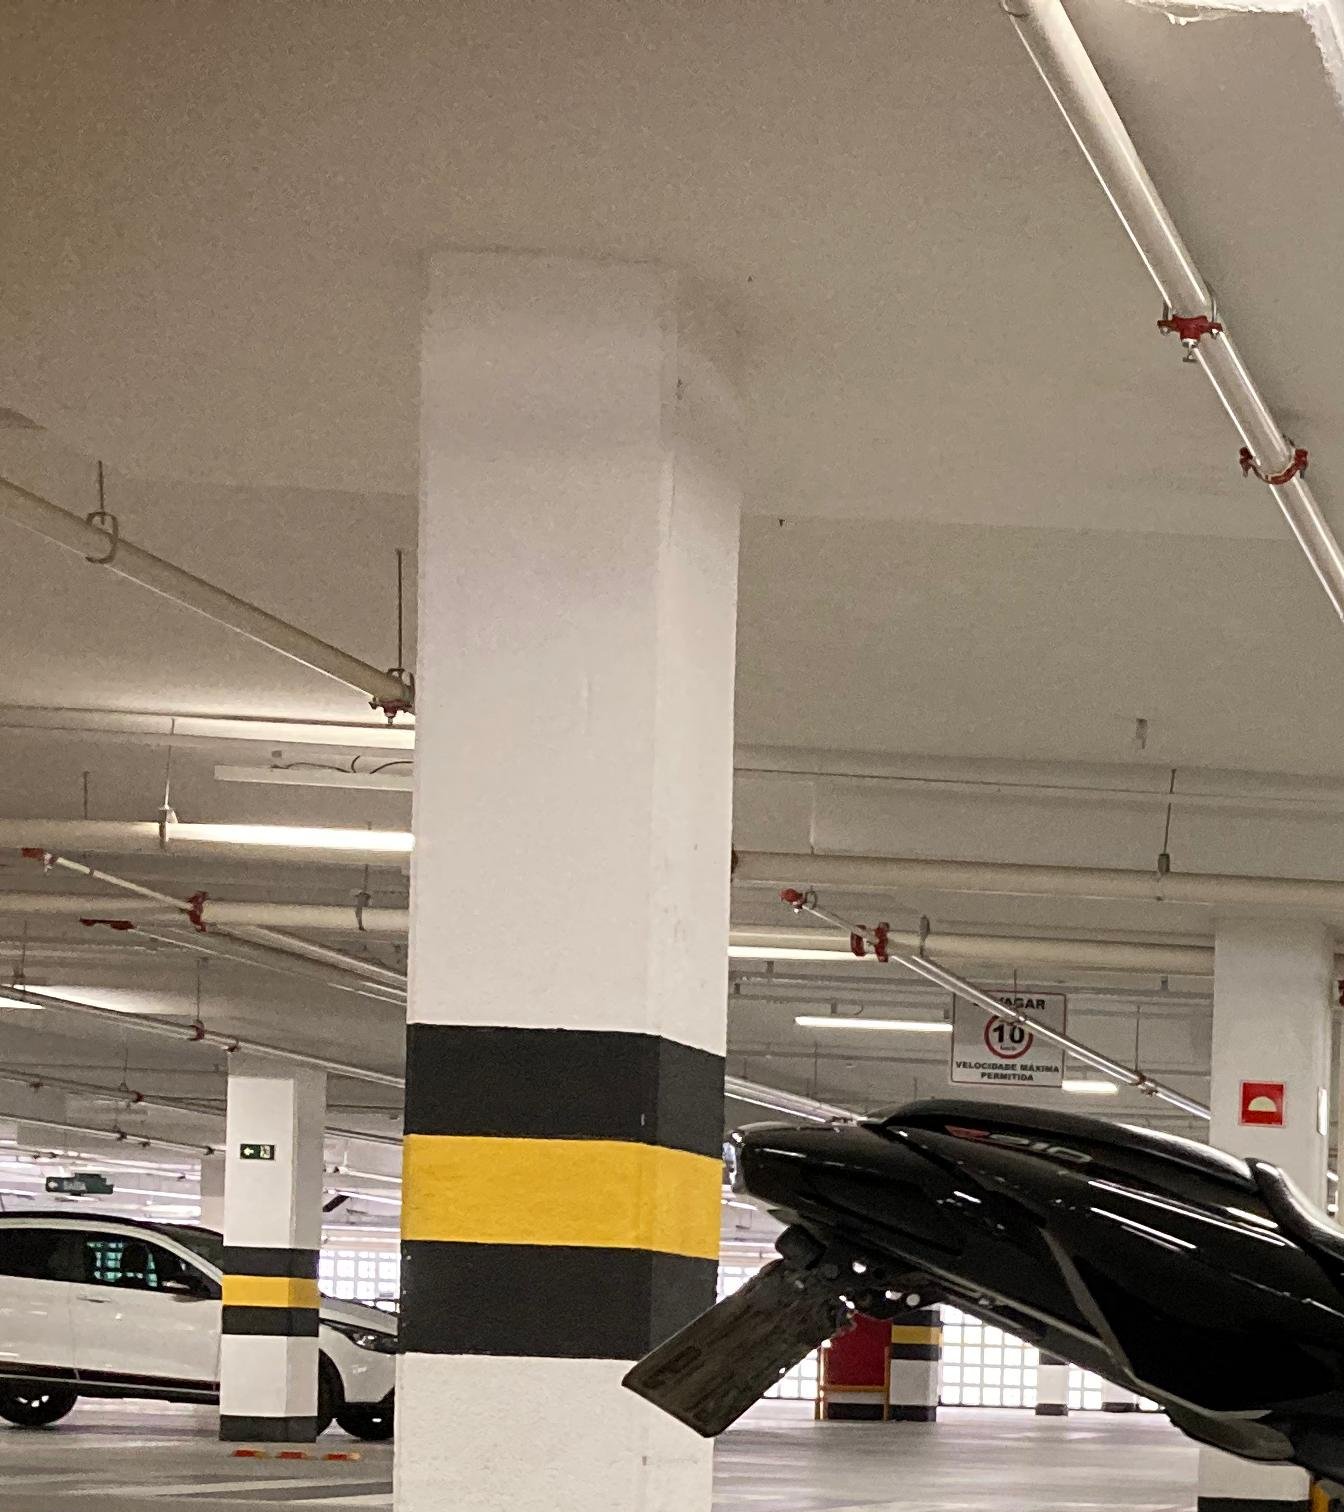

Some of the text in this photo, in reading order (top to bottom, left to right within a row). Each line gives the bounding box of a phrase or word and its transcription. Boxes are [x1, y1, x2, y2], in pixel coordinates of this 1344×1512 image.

[992, 1023, 1025, 1044] 10
[955, 1061, 1060, 1073] VELOCIDADE MÁXIMA
[980, 1071, 1034, 1081] PERMITIDA
